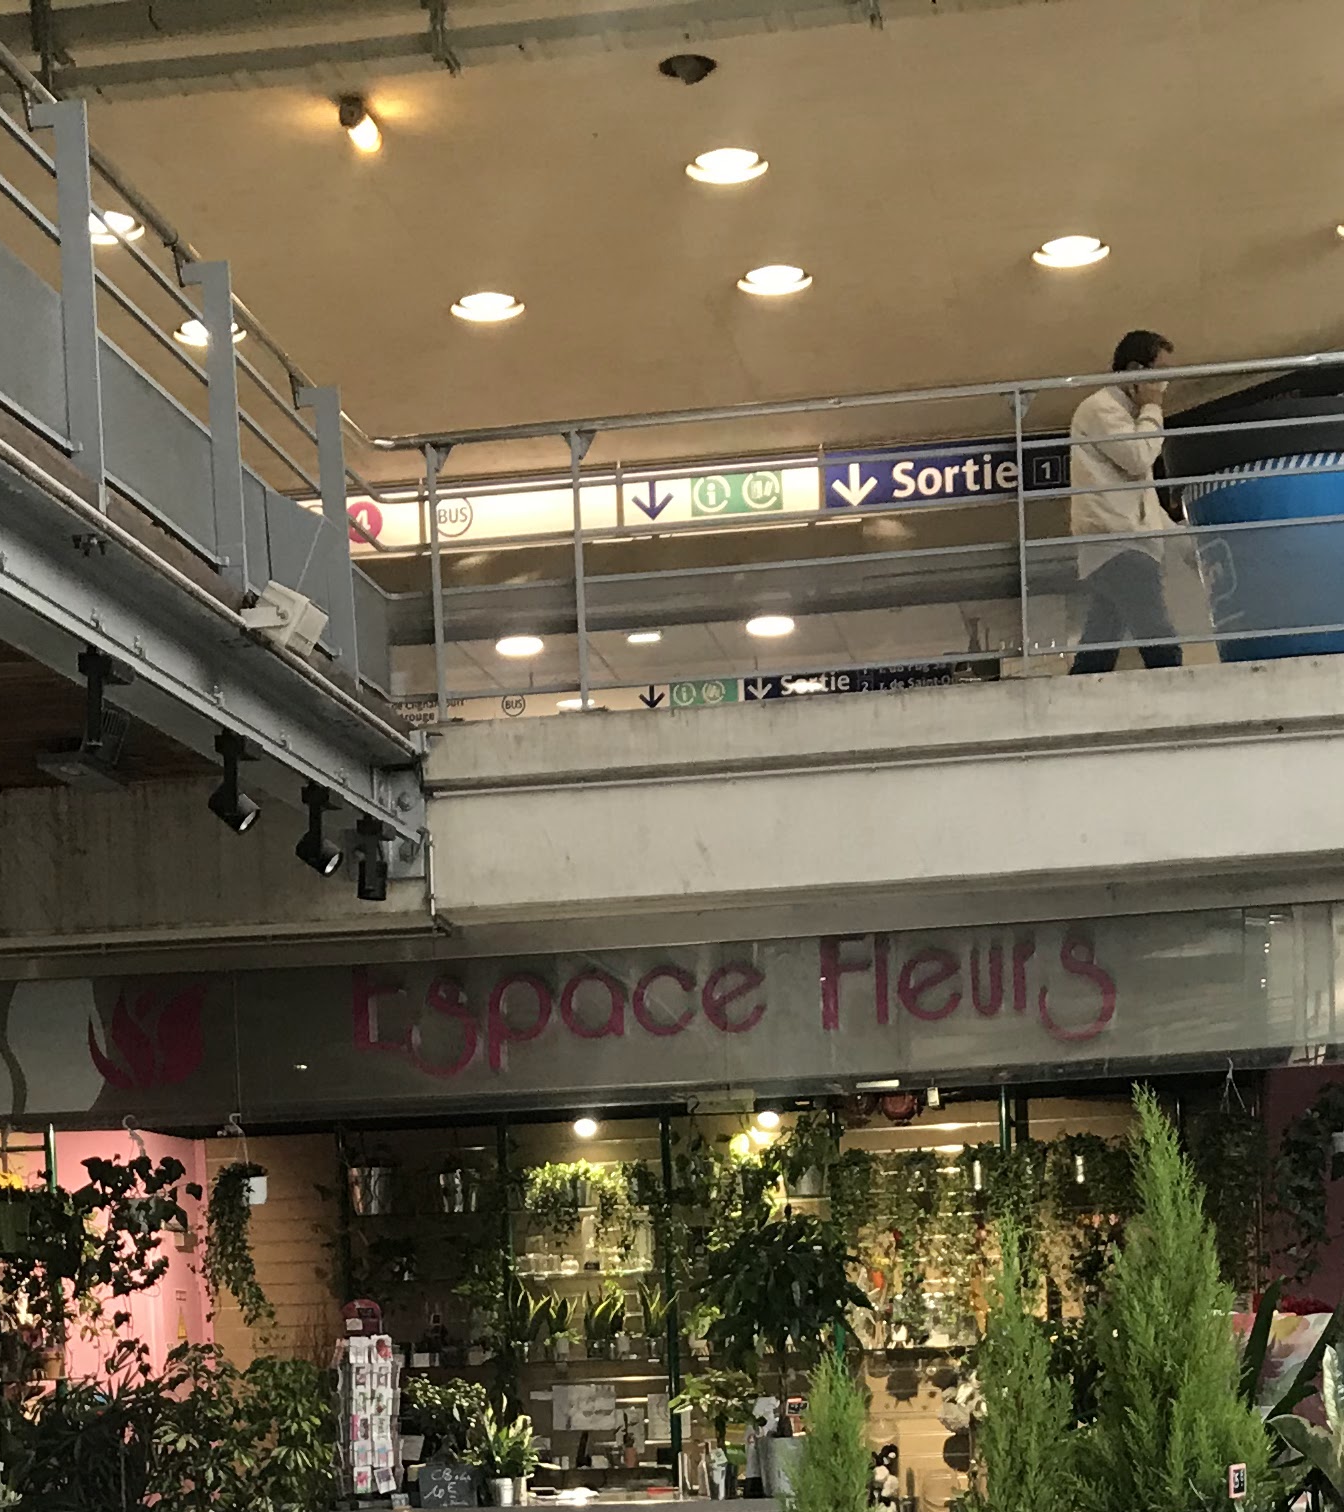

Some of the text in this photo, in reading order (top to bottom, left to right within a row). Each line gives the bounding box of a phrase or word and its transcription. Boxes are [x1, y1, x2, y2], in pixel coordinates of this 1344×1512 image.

[891, 453, 1051, 499] Sortie 1
[437, 507, 469, 525] BUS
[505, 699, 523, 710] BUS
[352, 934, 1119, 1077] Espace Fleurs
